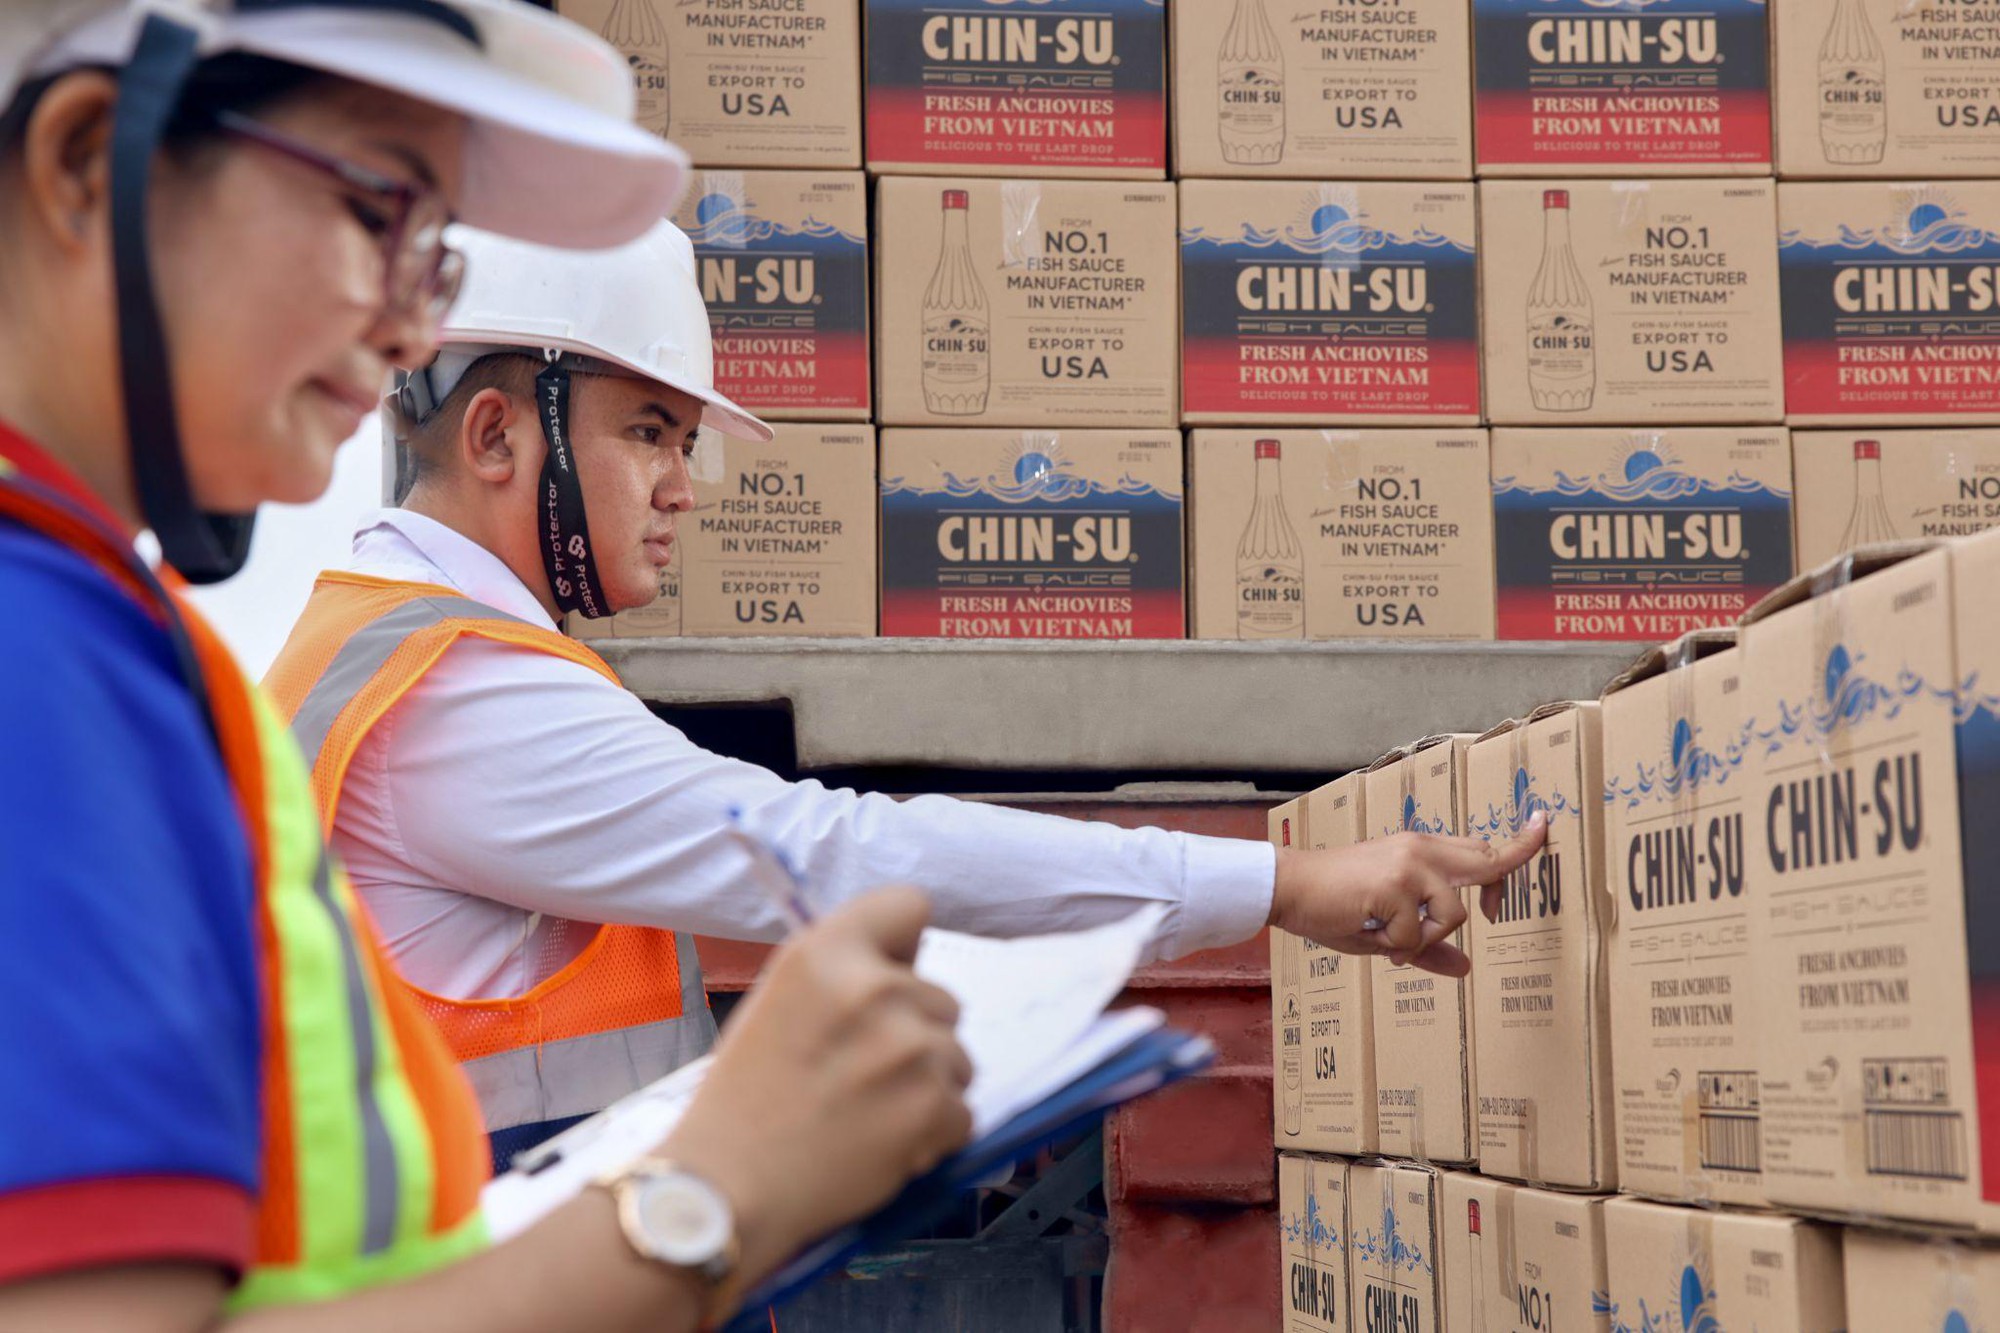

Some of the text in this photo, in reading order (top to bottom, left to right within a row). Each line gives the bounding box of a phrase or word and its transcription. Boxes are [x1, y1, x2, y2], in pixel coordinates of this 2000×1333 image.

[706, 0, 805, 11] FISH SAUCE
[686, 13, 826, 31] MANUFACTURER
[1320, 10, 1417, 25] FISH SAUCE
[1921, 9, 1957, 22] FISH
[707, 33, 724, 47] IN
[922, 15, 1114, 65] CHIN-SU
[1301, 28, 1437, 43] MANUFACTURER
[1527, 19, 1718, 64] CHIN-SU
[1322, 48, 1338, 60] IN
[1922, 47, 1938, 59] IN
[708, 76, 805, 89] EXPORT TO
[1007, 75, 1114, 88] SAUCE
[1612, 74, 1718, 86] SAUCE
[1224, 90, 1281, 104] CHIN-SU
[1322, 89, 1417, 101] EXPORT TO
[1924, 87, 1991, 100] EXPORT
[721, 93, 791, 117] USA
[924, 95, 1114, 115] FRESH ANCHOVIES
[1532, 96, 1720, 113] FRESH ANCHOVIES
[1336, 106, 1403, 128] USA
[1938, 105, 2000, 127] USA
[924, 116, 1114, 138] FROM VIETNAM
[1532, 118, 1721, 135] FROM VIETNAM
[924, 140, 1115, 155] DELICIOUS TO THE LAST DROP
[1060, 218, 1092, 227] FROM
[1661, 214, 1692, 223] FROM
[1045, 231, 1108, 254] NO.1
[1646, 227, 1709, 249] NO.1
[1027, 257, 1125, 273] FISH SAUCE
[1629, 253, 1726, 267] FISH SAUCE
[1007, 276, 1145, 292] MANUFACTURER
[1610, 272, 1747, 286] MANUFACTURER
[1236, 266, 1427, 313] CHIN-SU
[1631, 291, 1647, 304] IN
[1028, 296, 1044, 309] IN
[1321, 322, 1427, 335] SAUCE
[713, 338, 816, 355] NCHOVIES
[928, 338, 986, 352] CHIN-SU
[1029, 338, 1124, 351] EXPORT TO
[1533, 336, 1591, 349] CHIN-SU
[1632, 333, 1728, 345] EXPORT TO
[1240, 345, 1428, 363] FRESH ANCHOVIES
[1646, 350, 1714, 372] USA
[1838, 346, 1905, 362] FRESH
[713, 360, 816, 378] IETNAM
[1042, 356, 1110, 379] USA
[1240, 366, 1429, 386] FROM VIETNAM
[1838, 367, 1909, 385] FROM
[1240, 390, 1429, 401] DELICIOUS TO THE LAST DROP
[548, 386, 568, 472] Protector
[756, 460, 788, 470] FROM
[1373, 465, 1404, 474] FROM
[740, 473, 804, 496] NO.1
[1358, 478, 1421, 500] NO.1
[721, 499, 822, 515] FISH SAUCE
[1340, 505, 1438, 519] FISH SAUCE
[1942, 505, 1979, 517] FISH
[548, 479, 564, 571] Protector
[700, 519, 842, 535] MANUFACTURER
[1321, 524, 1459, 537] MANUFACTURER
[722, 538, 739, 552] IN
[938, 516, 1131, 562] CHIN-SU
[1550, 514, 1742, 560] CHIN-SU
[1342, 543, 1358, 556] IN
[1023, 573, 1131, 585] SAUCE
[1636, 571, 1743, 582] SAUCE
[575, 564, 600, 617] Protecto
[722, 582, 820, 595] EXPORT TO
[1242, 588, 1300, 601] CHIN-SU
[1343, 585, 1438, 597] EXPORT TO
[941, 597, 1132, 613] FRESH ANCHOVIES
[1555, 594, 1745, 610] FRESH ANCHOVIES
[736, 600, 805, 624] USA
[1357, 603, 1424, 626] USA
[940, 618, 1132, 636] FROM VIETNAM
[1554, 615, 1625, 633] FROM
[1767, 752, 1923, 874] CHIN-SU
[1628, 813, 1744, 912] CHIN-SU
[1498, 853, 1561, 923] HIN-SU
[1501, 977, 1520, 991] FRESH
[1651, 976, 1731, 998] FRESH ANCHOVIES
[1501, 994, 1553, 1013] FROM VIETNAM
[1652, 1004, 1733, 1028] FROM VIETNAM
[1311, 1019, 1341, 1038] EXPORT TO
[1315, 1046, 1337, 1080] USA
[1291, 1262, 1335, 1324] CHIN-SU
[1365, 1283, 1420, 1333] CHIN-SU
